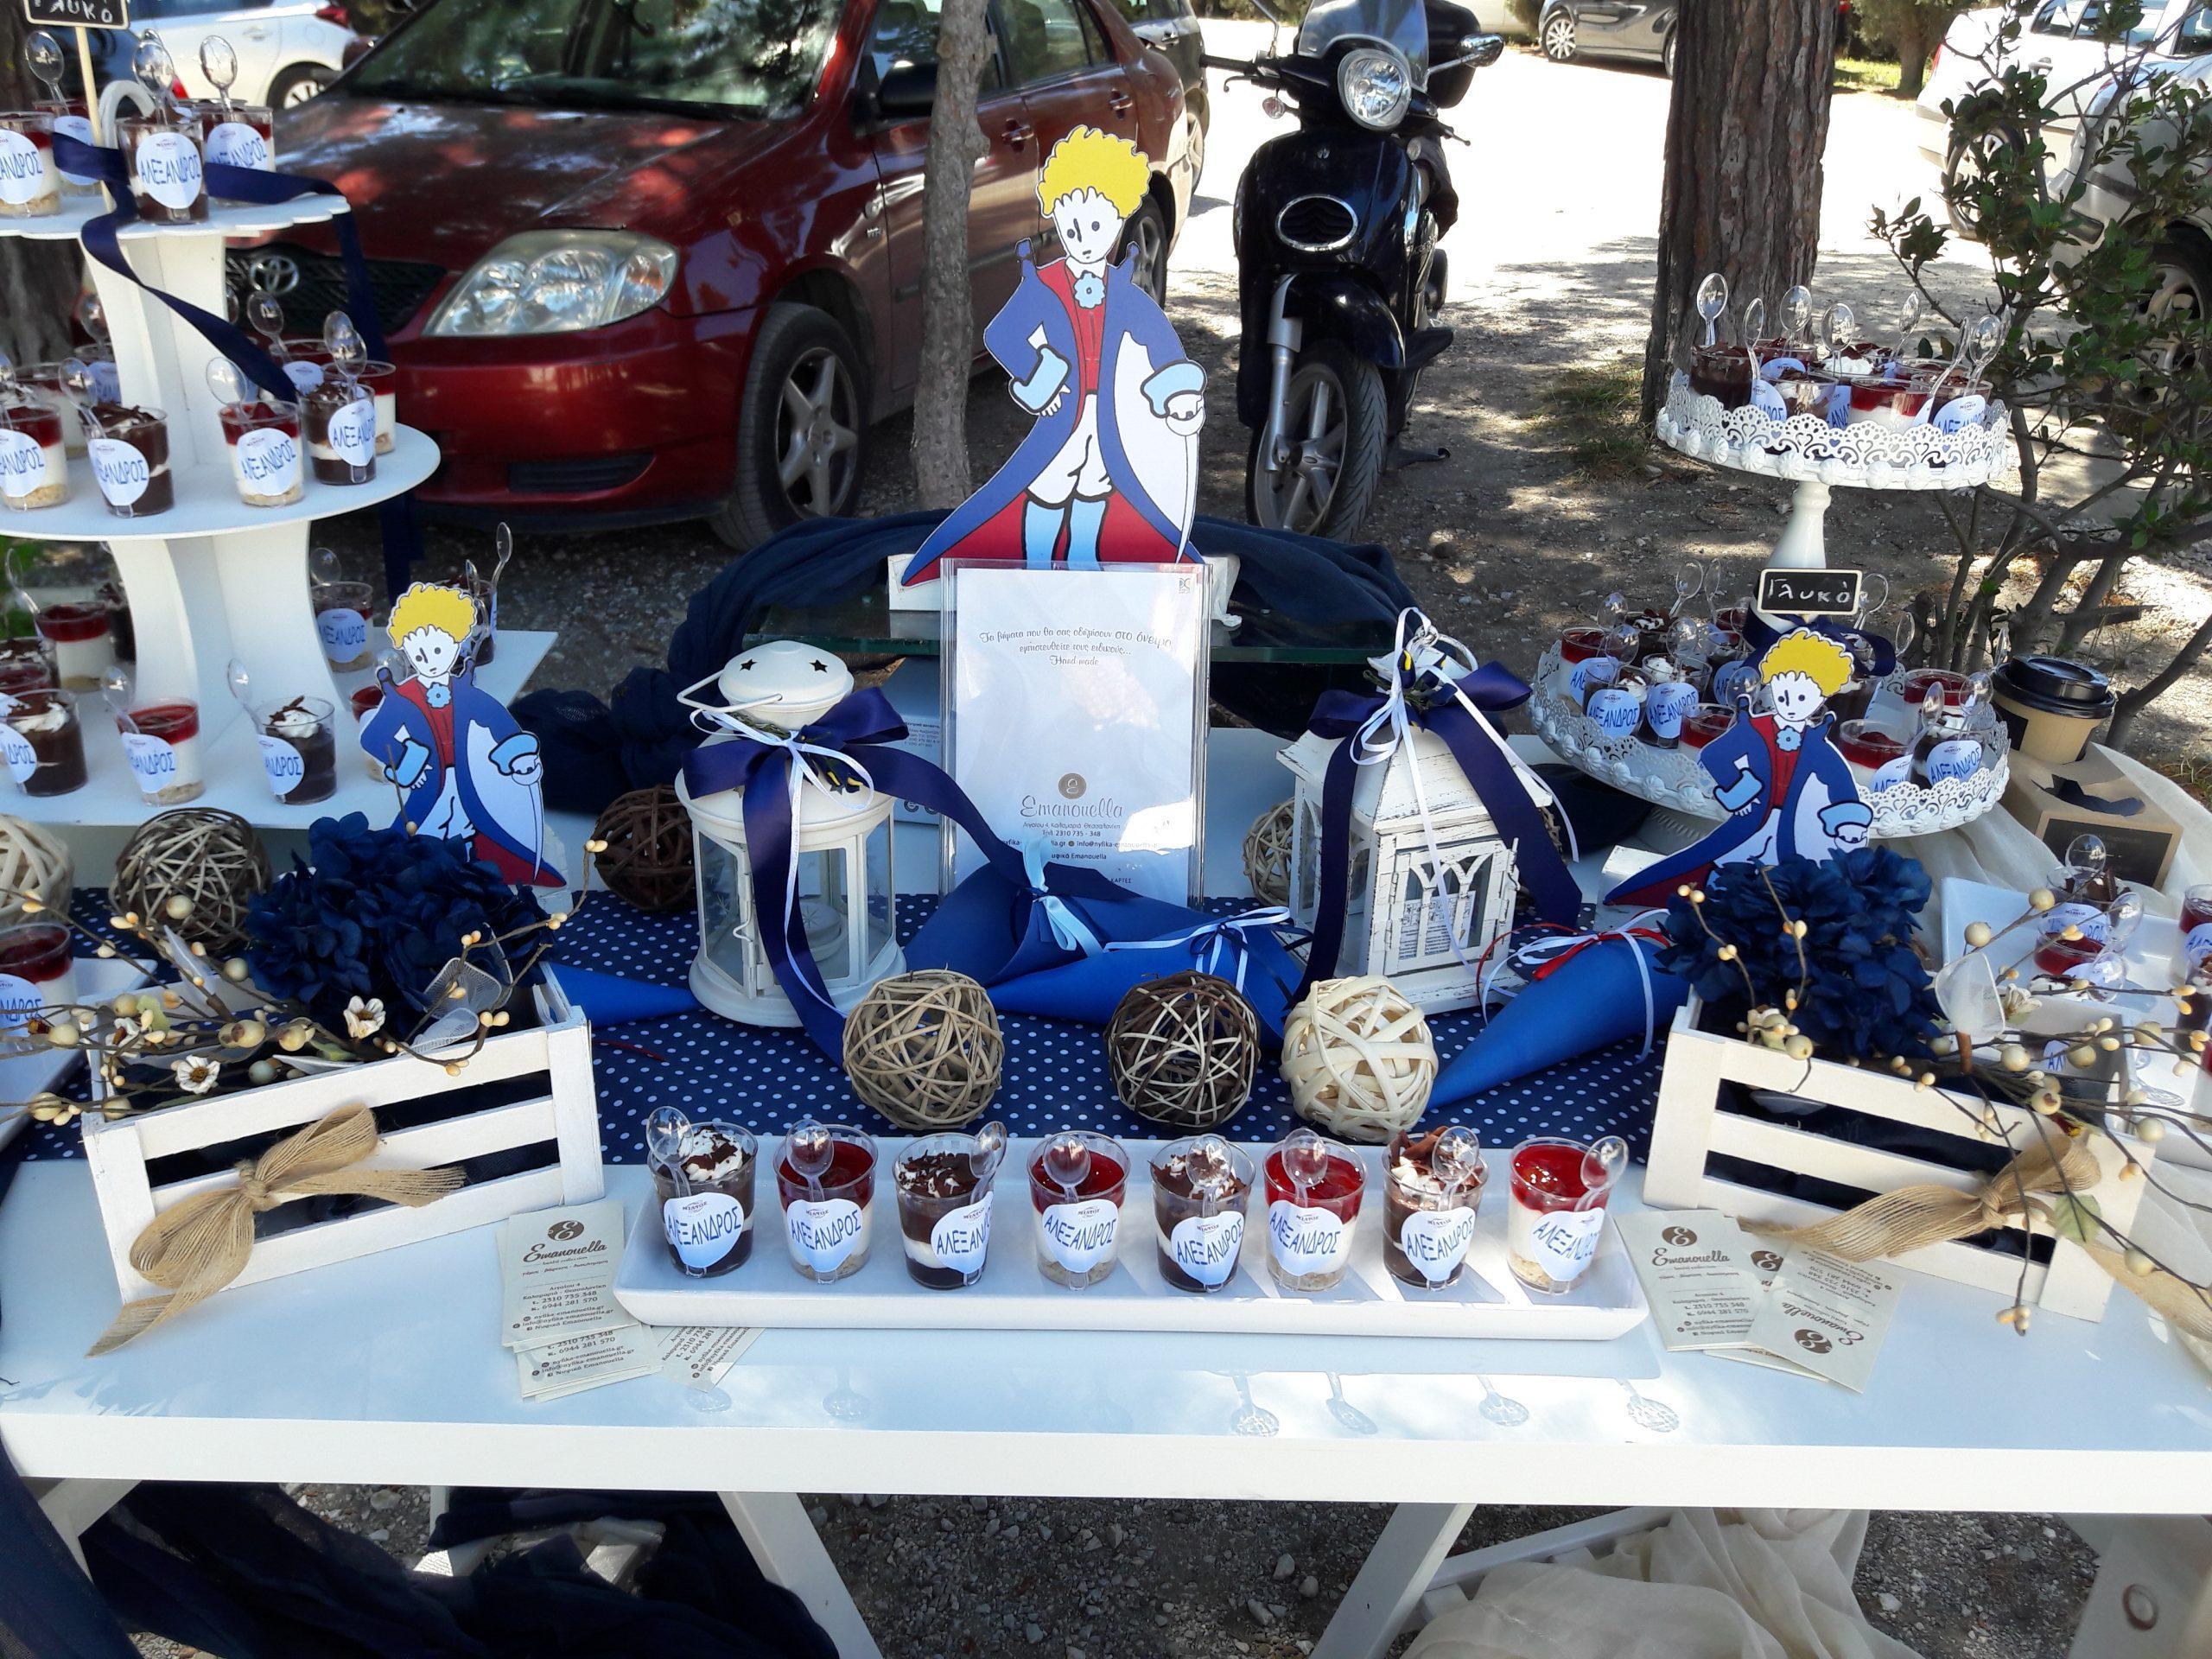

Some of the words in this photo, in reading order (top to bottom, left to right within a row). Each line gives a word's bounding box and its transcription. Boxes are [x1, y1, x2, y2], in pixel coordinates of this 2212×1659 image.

[0, 151, 42, 180] ΑΝΔΡΟΣ
[0, 446, 45, 475] ΑΝΔΡΟΣ
[1768, 578, 1850, 603] Γλυκό
[979, 631, 995, 643] Τα
[997, 631, 1024, 642] βήματα
[1027, 629, 1041, 638] που
[1043, 626, 1053, 636] θα
[1056, 629, 1071, 638] σας
[1116, 631, 1133, 640] στο
[1072, 643, 1089, 652] τους
[1049, 655, 1076, 665] Hand
[1078, 656, 1099, 665] made
[1020, 795, 1122, 818] Emanouella
[668, 1206, 741, 1245] ΑΛΕΞΑΝΔΡΟΣ
[791, 1210, 861, 1250] ΑΛΕΞΑΝΔΡΟΣ
[1044, 1214, 1117, 1251] ΑΛΕΞΑΝΔΡΟΣ
[1269, 1211, 1341, 1255] ΑΛΕΞΑΝΔΡΟΣ
[1177, 1218, 1243, 1265] ΑΛΕΞΑΝΔΡΟΣ
[1407, 1215, 1474, 1261] ΑΛΕΞΑΝΔΡΟΣ
[523, 1240, 607, 1262] Emanouella
[1652, 1247, 1730, 1266] Emanouella
[1782, 1302, 1865, 1345] Emanouella
[557, 1338, 577, 1347] 2310
[680, 1338, 696, 1351] 2310
[690, 1340, 704, 1353] 6944
[702, 1330, 715, 1339] 281
[584, 1357, 624, 1369] Emanouella
